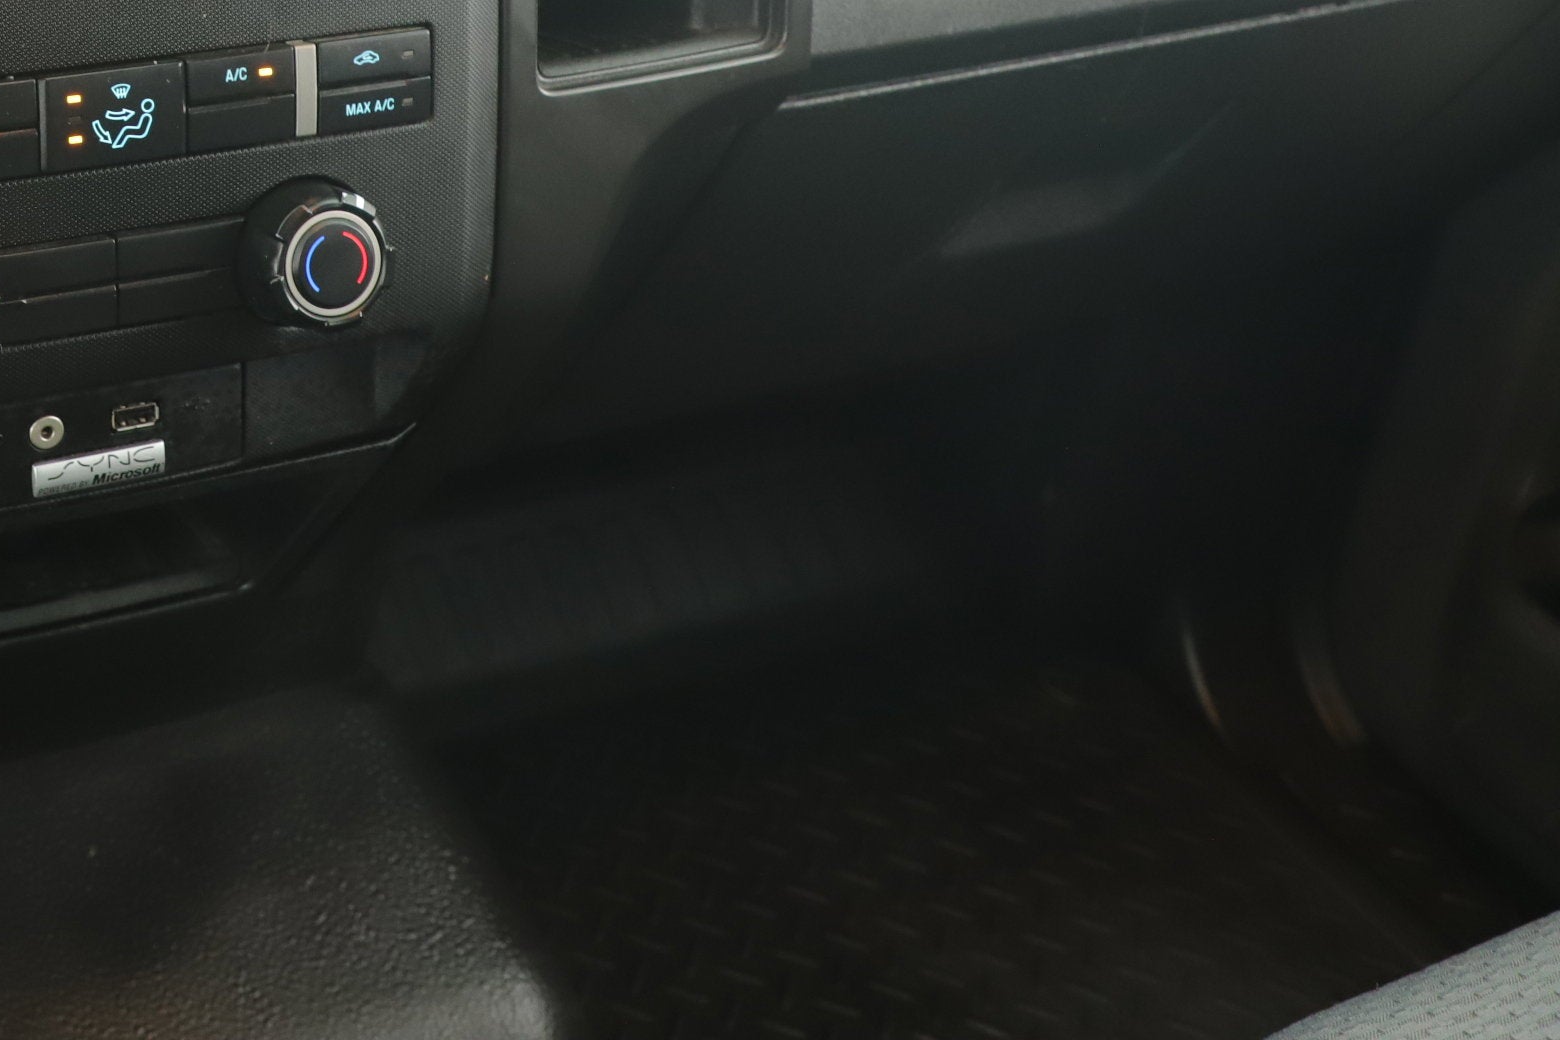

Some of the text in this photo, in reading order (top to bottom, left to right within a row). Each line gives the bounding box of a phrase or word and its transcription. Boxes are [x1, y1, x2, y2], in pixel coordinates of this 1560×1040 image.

[225, 66, 248, 83] A/C
[345, 97, 395, 116] MAX A/C
[47, 444, 156, 482] SYNC
[92, 464, 160, 486] Microsoft
